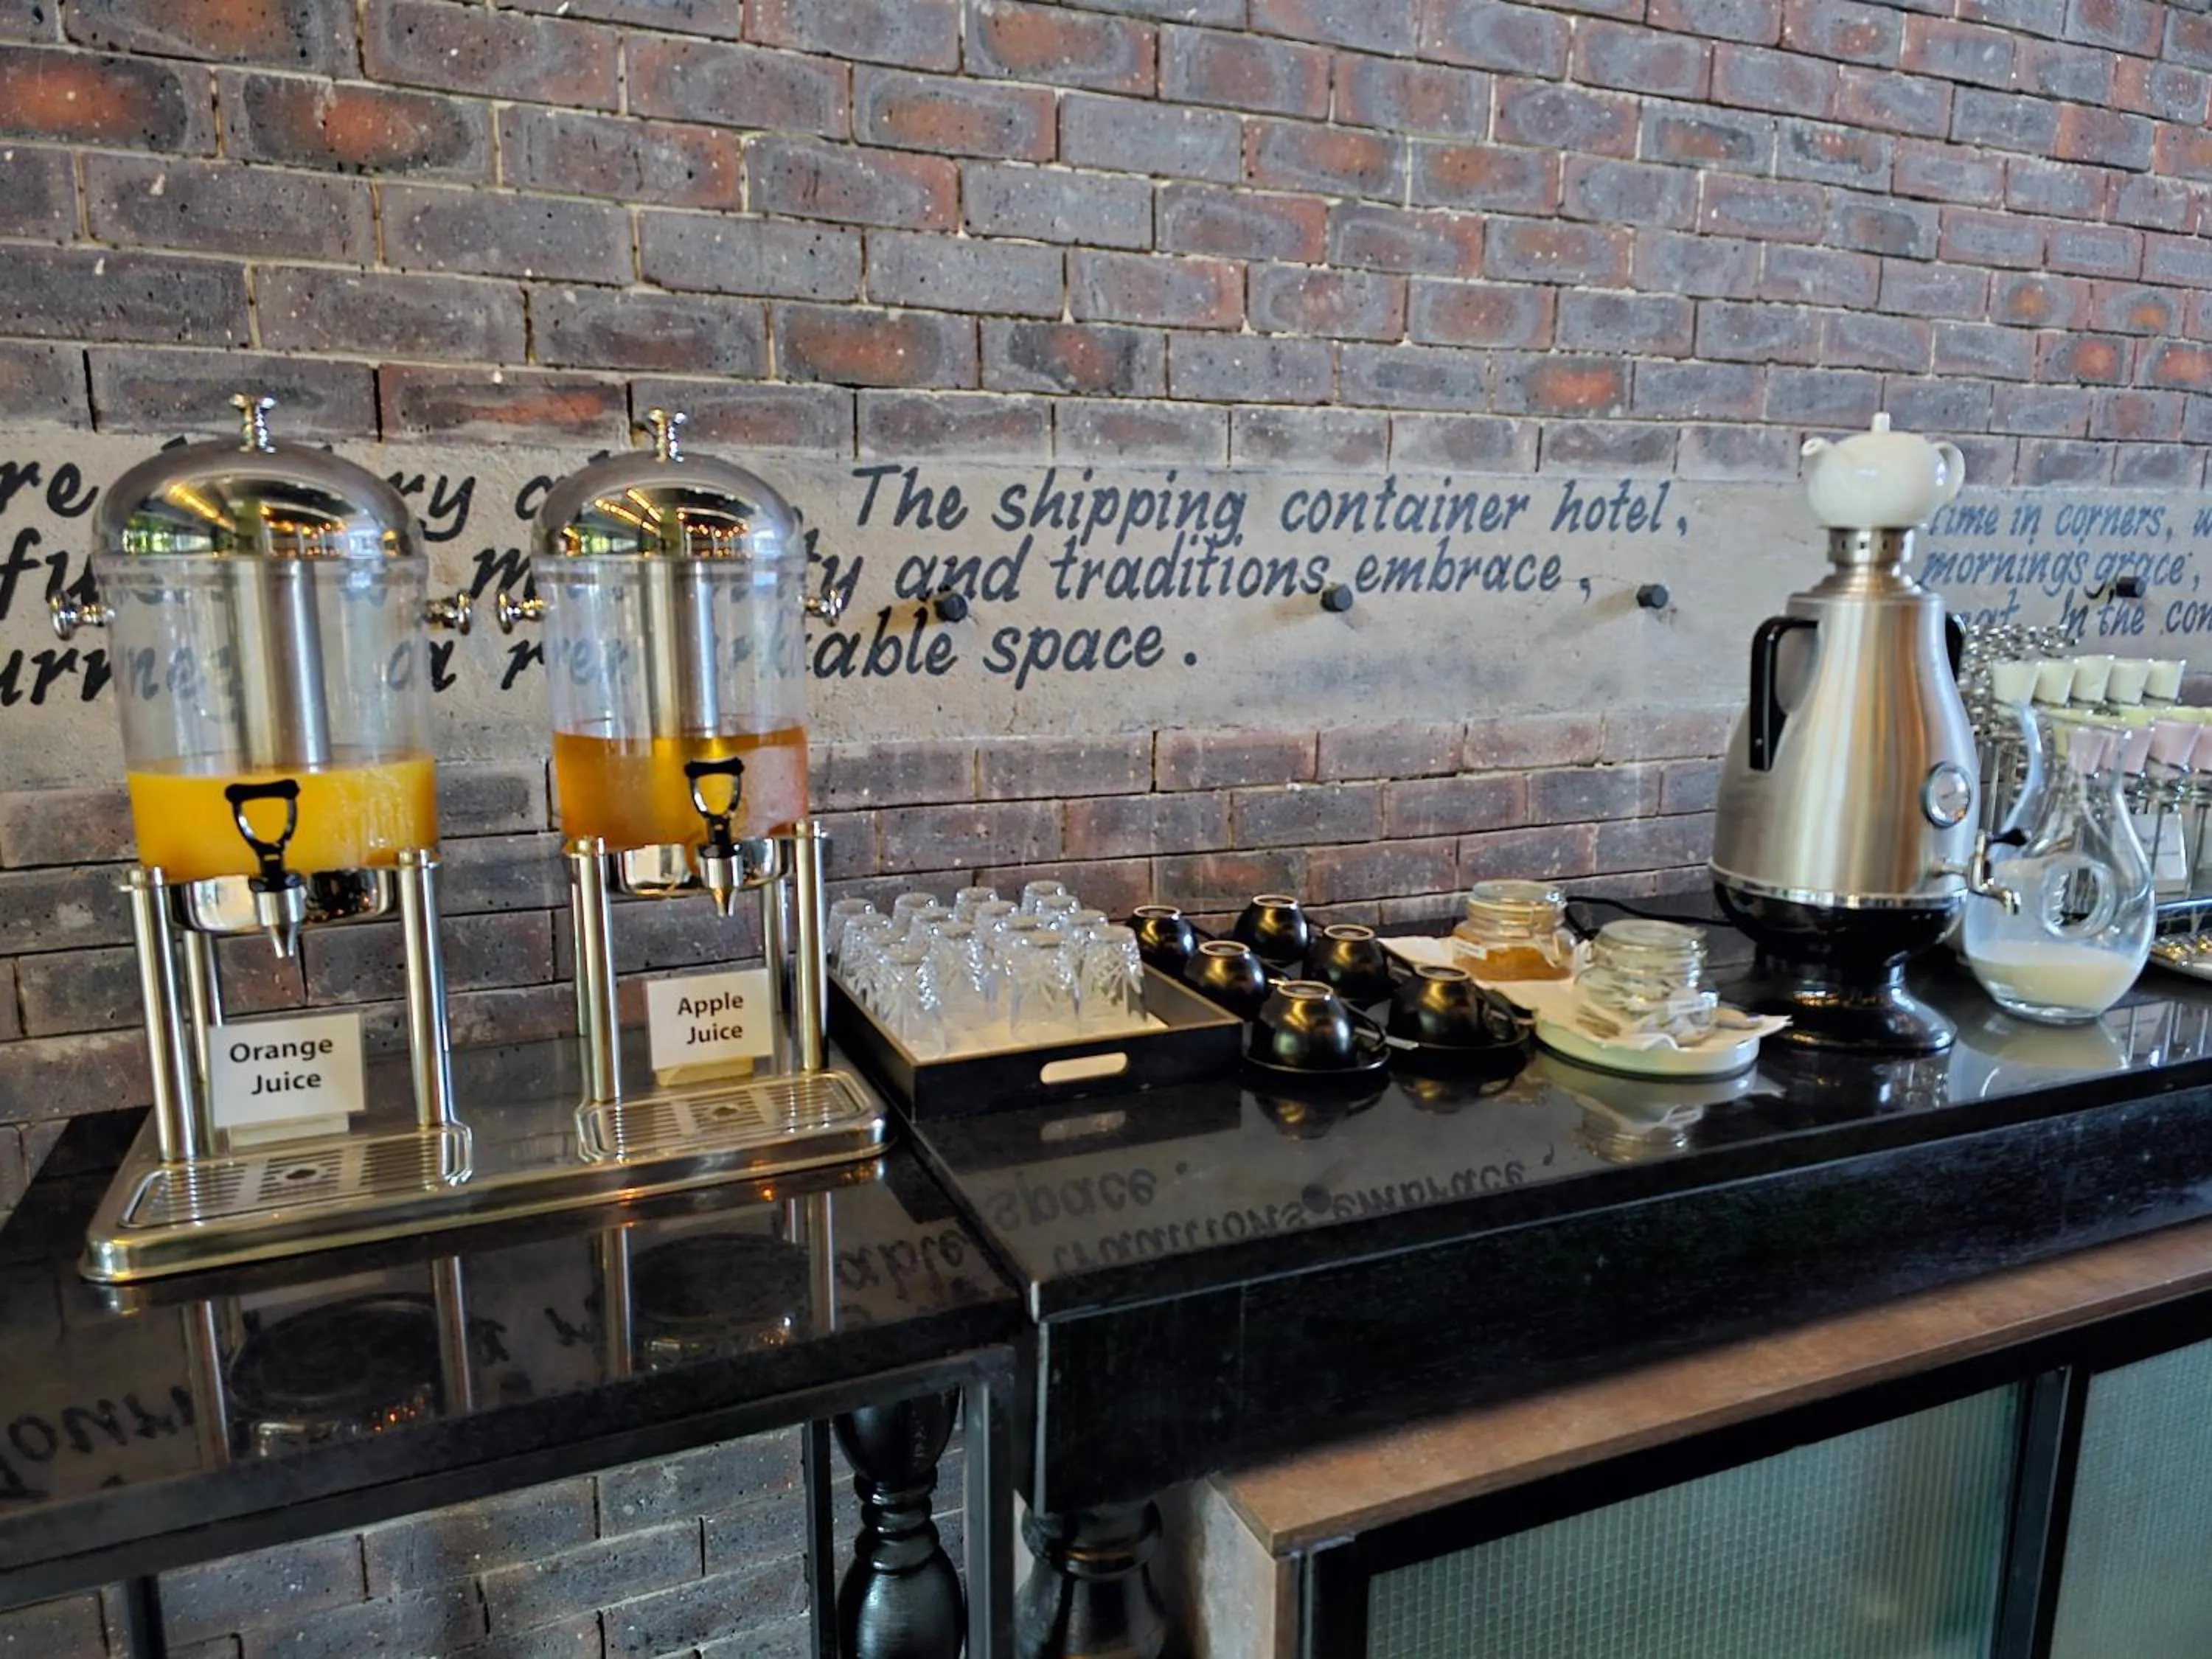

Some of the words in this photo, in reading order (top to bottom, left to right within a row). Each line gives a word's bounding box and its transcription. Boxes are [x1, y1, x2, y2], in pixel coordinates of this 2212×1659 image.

[852, 465, 969, 530] The
[991, 467, 1247, 547] shipping
[1281, 473, 1531, 534] container
[1550, 479, 1688, 538] hotel,
[2009, 503, 2042, 537] in
[2055, 503, 2174, 543] corners,
[894, 534, 1033, 602] and
[1049, 531, 1332, 599] traditions
[1919, 551, 2090, 599] mornings
[2098, 599, 2146, 636] the
[678, 992, 745, 1018] Apple
[229, 1038, 334, 1063] Orange
[686, 1023, 744, 1045] Juice
[251, 1071, 322, 1096] Juice
